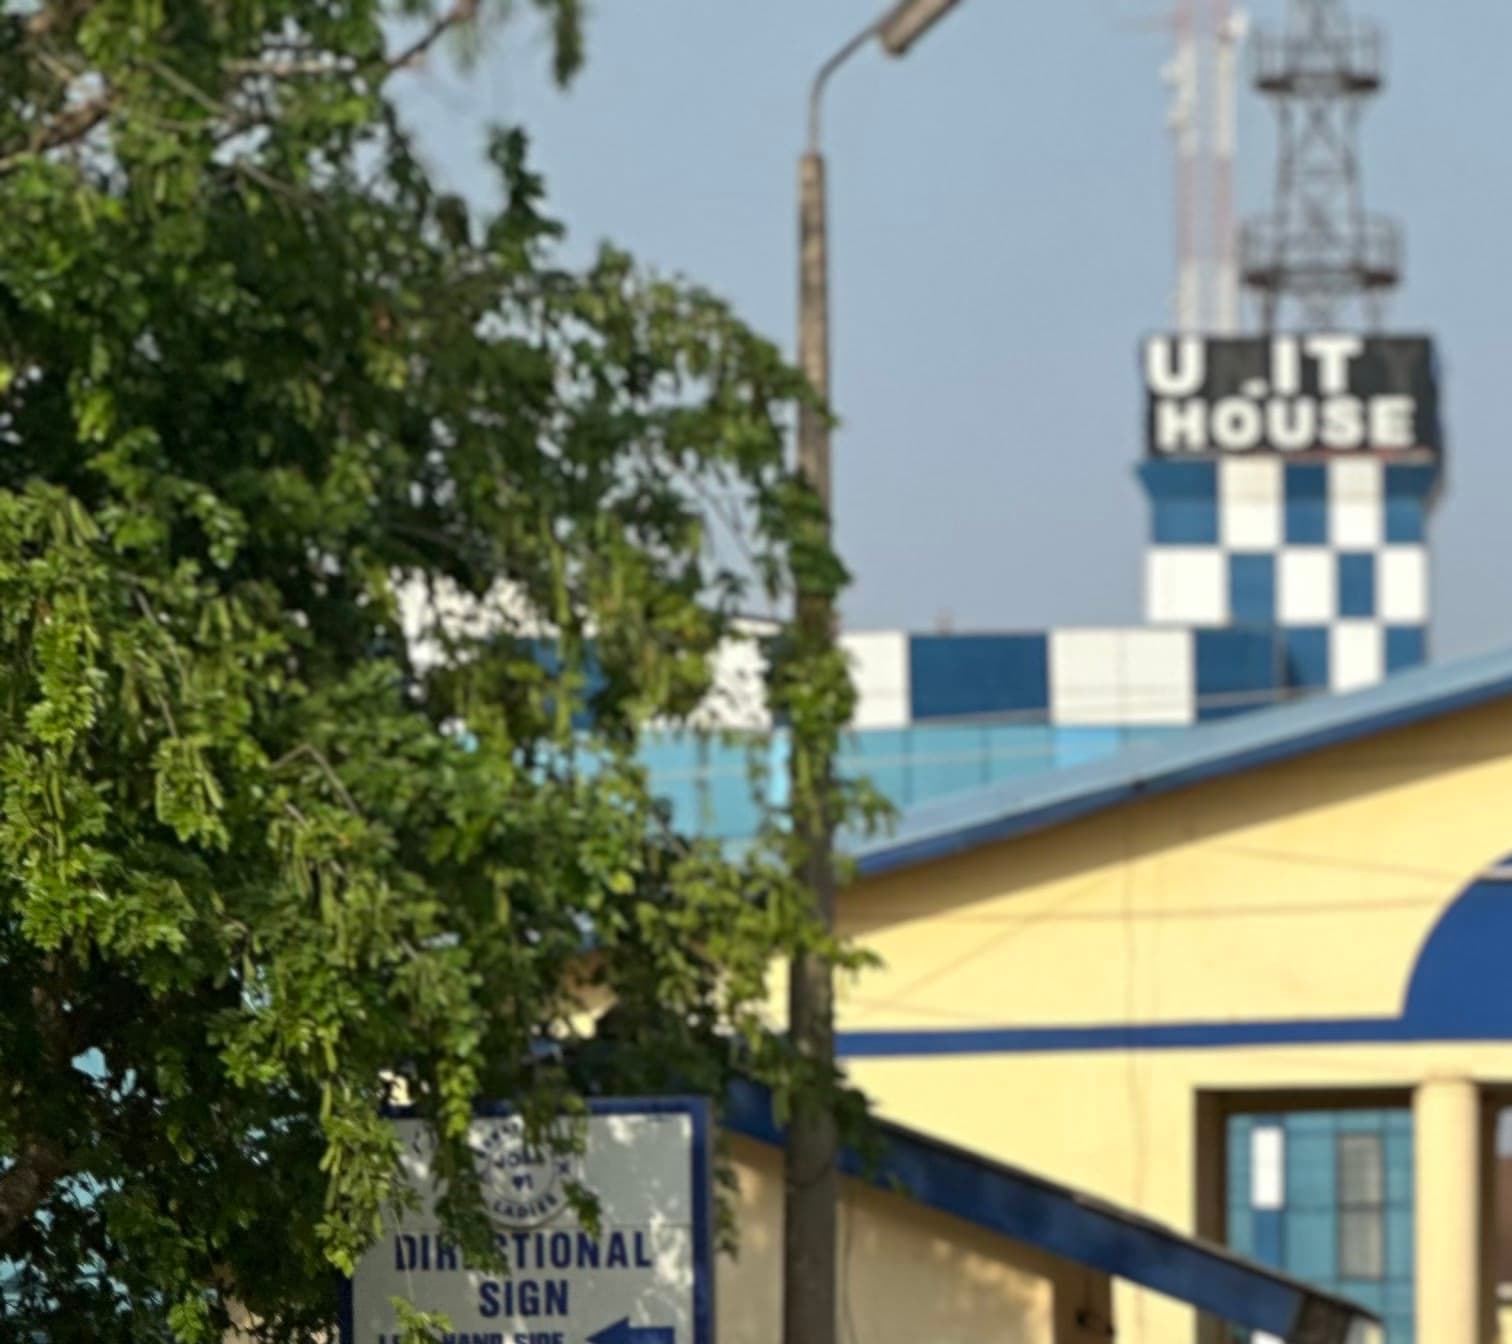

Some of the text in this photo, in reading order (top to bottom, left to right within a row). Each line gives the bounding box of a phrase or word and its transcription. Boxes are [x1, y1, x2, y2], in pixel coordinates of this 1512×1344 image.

[1155, 394, 1416, 450] HOUSE
[395, 1231, 653, 1271] DIRTIONAL
[479, 1280, 568, 1318] SIGN
